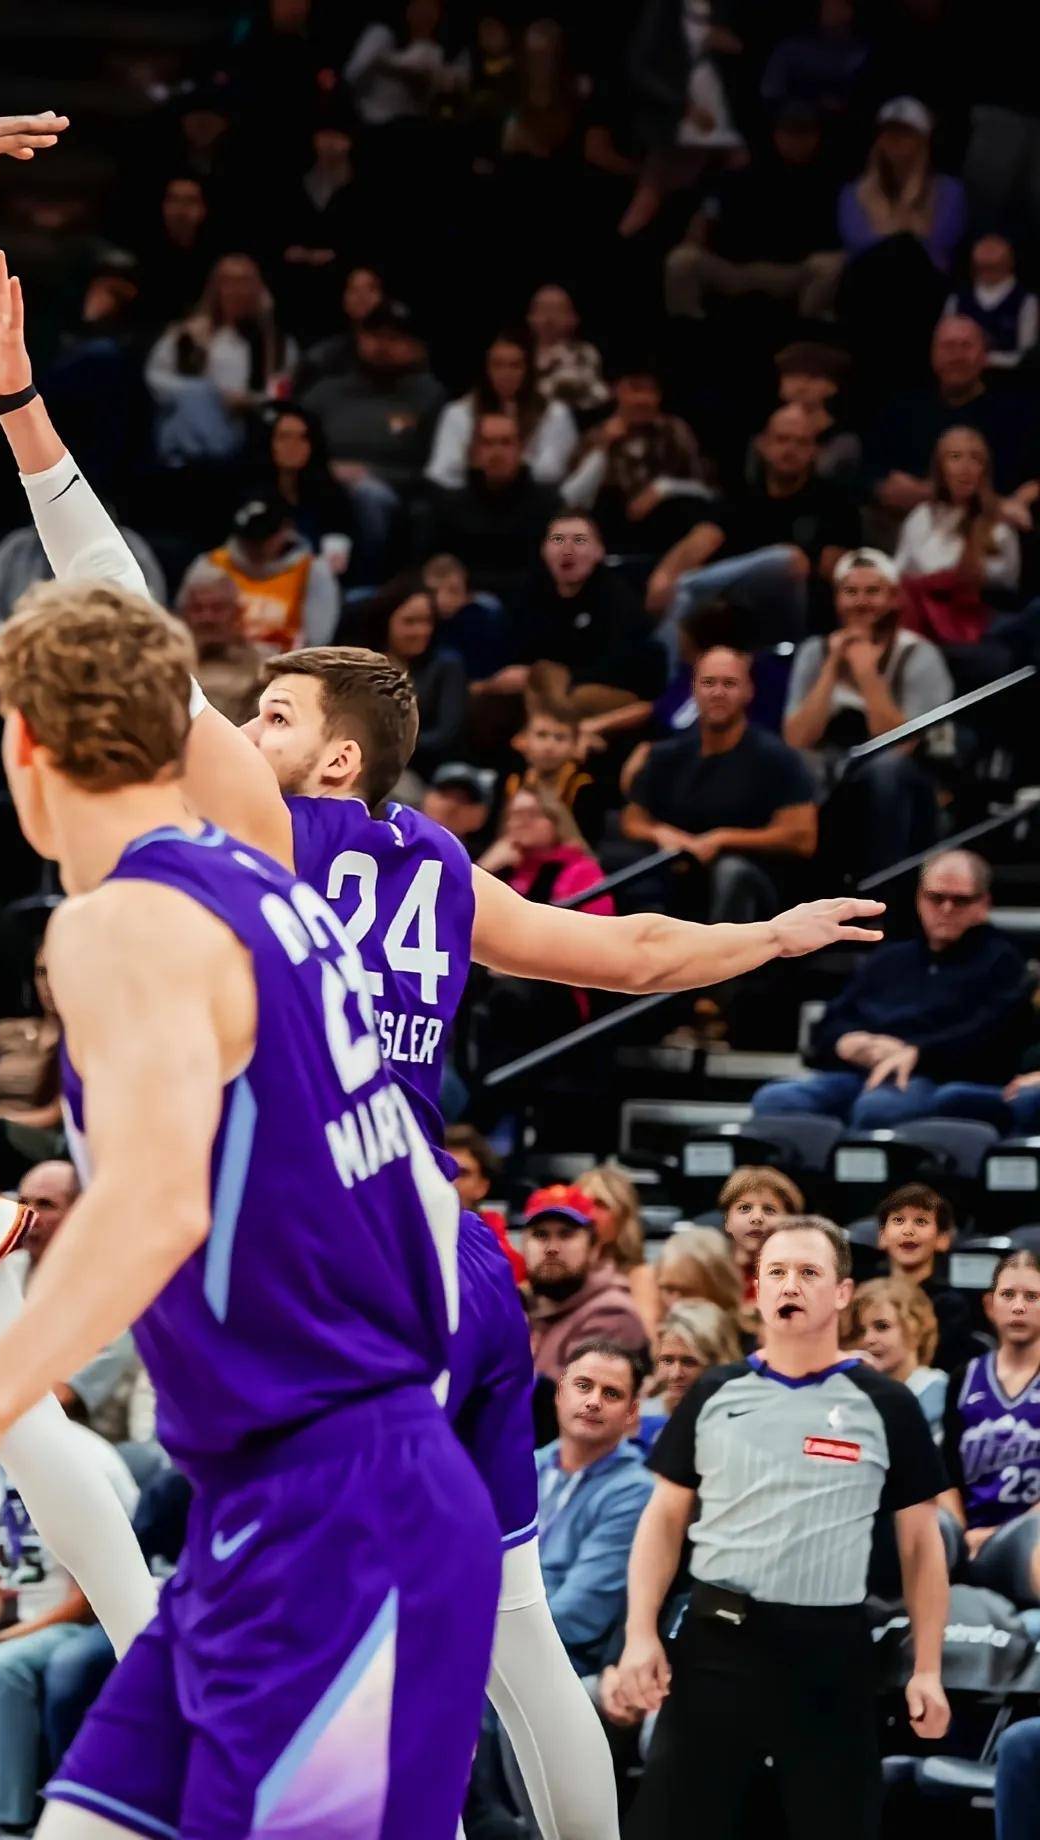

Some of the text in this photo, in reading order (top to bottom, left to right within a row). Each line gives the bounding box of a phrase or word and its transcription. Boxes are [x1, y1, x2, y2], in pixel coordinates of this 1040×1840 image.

[326, 850, 449, 1004] 24
[374, 1009, 444, 1064] SLER
[998, 1465, 1040, 1503] 23
